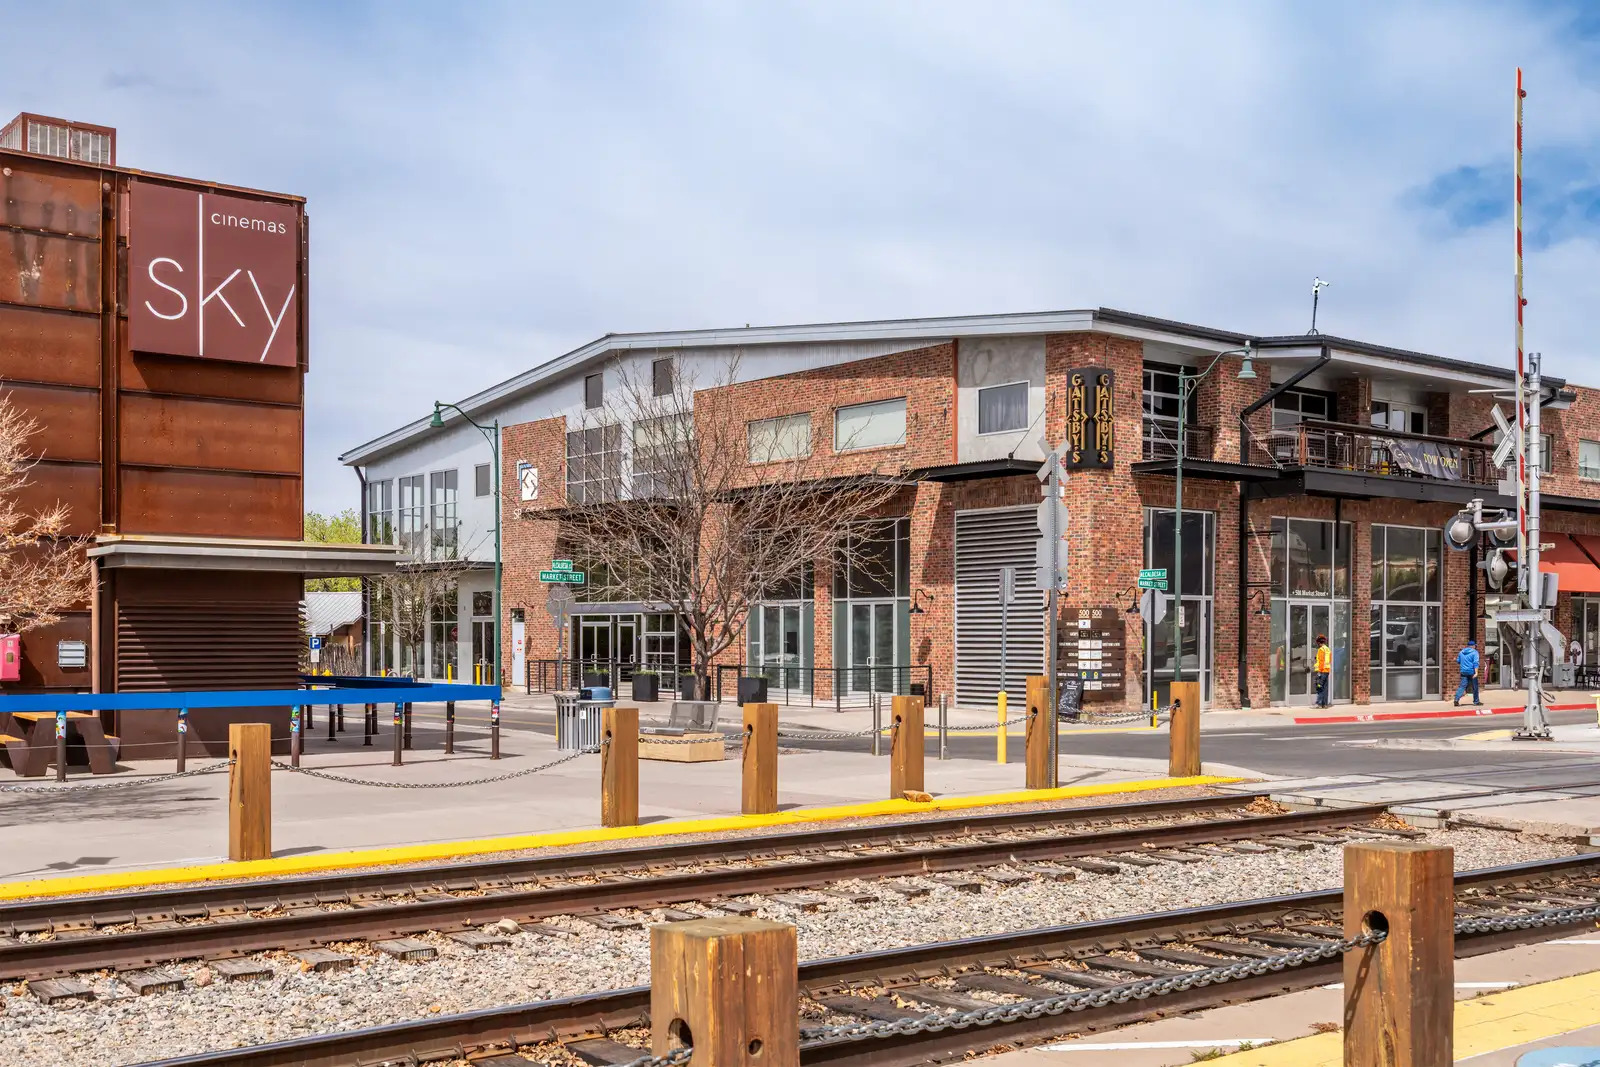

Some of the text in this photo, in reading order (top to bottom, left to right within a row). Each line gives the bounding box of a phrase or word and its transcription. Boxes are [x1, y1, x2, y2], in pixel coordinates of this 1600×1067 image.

[211, 213, 286, 234] cinemas
[145, 194, 295, 362] sky
[1072, 374, 1081, 463] GATSBY'S
[1100, 374, 1109, 463] GATSBY'S
[312, 638, 320, 648] P
